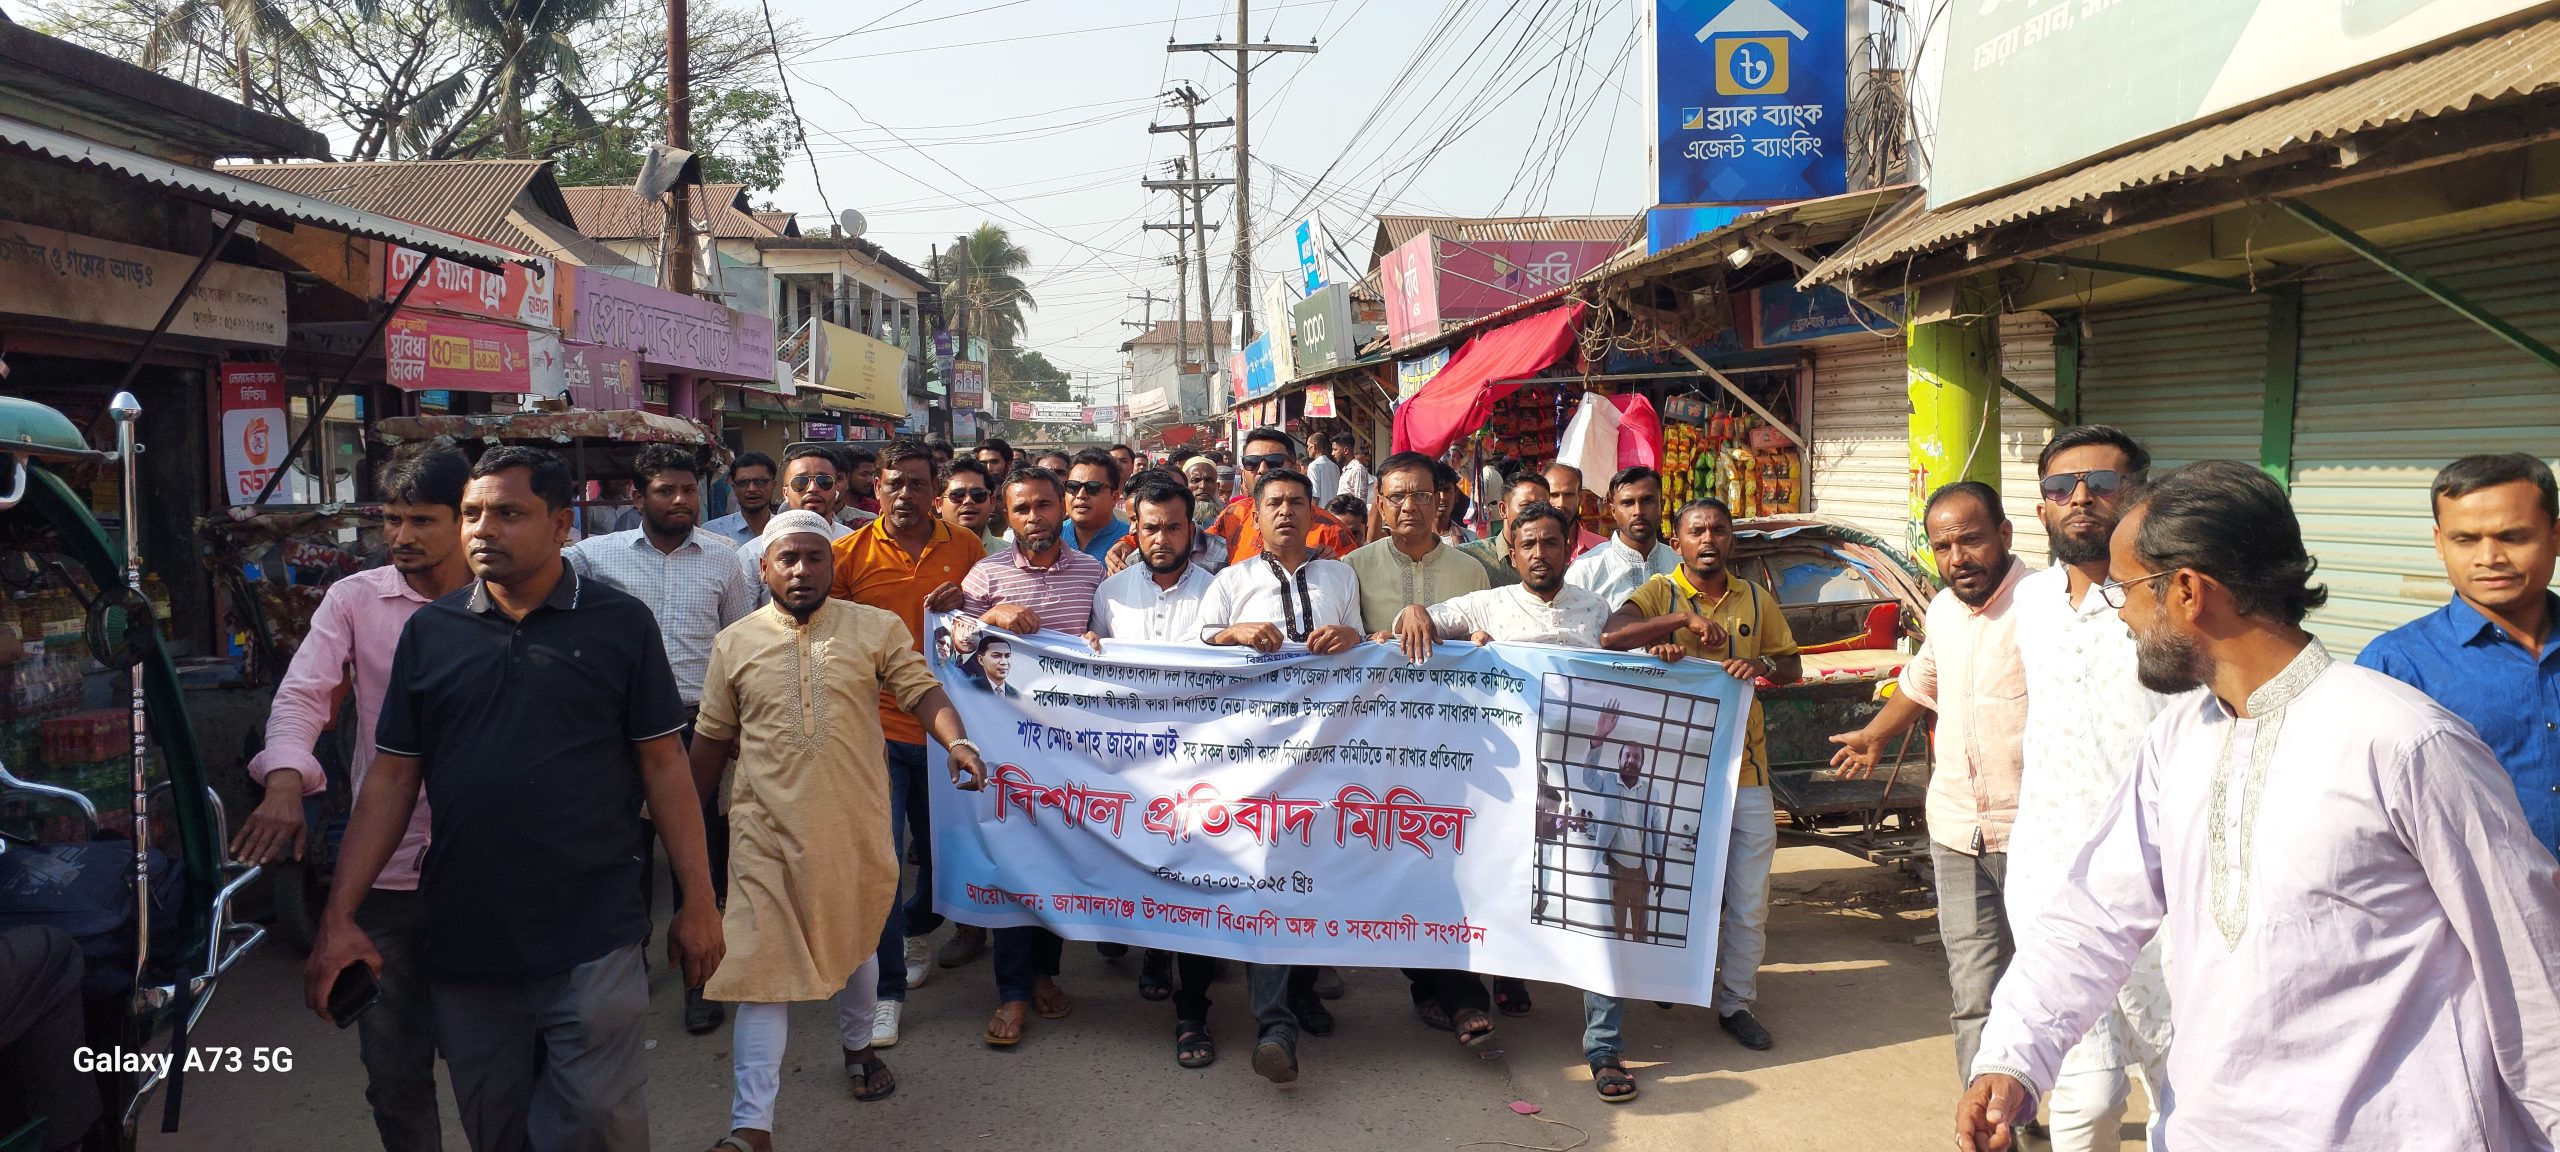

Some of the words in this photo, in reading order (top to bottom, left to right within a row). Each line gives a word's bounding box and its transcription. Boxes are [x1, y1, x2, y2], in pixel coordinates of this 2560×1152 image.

[1707, 106, 1757, 131] ব্র্যাক
[1762, 104, 1823, 128] ব্যাংক
[1683, 133, 1746, 160] এজেন্ট
[1751, 129, 1824, 159] ব্যাংকিং
[66, 248, 106, 278] গমের
[1403, 253, 1420, 303] রবি
[1526, 250, 1572, 289] রবি
[390, 328, 427, 360] সুবিধা
[588, 291, 684, 361] পোশাক
[685, 307, 732, 369] বাড়ি
[1303, 313, 1326, 353] oppo
[390, 358, 426, 382] ডাবল
[431, 339, 452, 366] ৫০
[1038, 655, 1088, 677] বাংলাদেশ
[1164, 670, 1181, 687] দল
[1184, 669, 1227, 691] বিএনপি
[1283, 664, 1330, 686] উপজেলা
[1332, 666, 1364, 685] শাখার
[1366, 667, 1388, 685] সদ্য
[1388, 662, 1425, 684] ঘোষিত
[1480, 666, 1526, 694] কমিটিতে
[1033, 684, 1071, 708] সর্বোচ্চ
[1073, 693, 1100, 710] ত্যাগ
[1102, 690, 1141, 712] স্বীকারী
[1145, 698, 1169, 712] কারা
[1172, 695, 1219, 714] নির্যাতিত
[1220, 697, 1246, 718] নেতা
[1249, 698, 1300, 719] জামালগঞ্জ
[1302, 695, 1350, 719] উপজেলা
[1350, 694, 1398, 719] বিএনপির
[1400, 700, 1434, 721] সাবেক
[1438, 702, 1479, 725] সাধারণ
[1481, 706, 1524, 729] সম্পাদক
[1017, 718, 1043, 751] শাহ
[1048, 726, 1073, 752] মোঃ
[1075, 730, 1104, 761] শাহ
[1106, 729, 1149, 761] জাহান
[1152, 725, 1181, 764] ভাই
[1183, 740, 1199, 762] সহ
[1200, 741, 1225, 764] সকল
[1226, 738, 1255, 764] ত্যাগী
[1258, 743, 1280, 765] কারা
[1281, 739, 1337, 766] নির্যাতিতদের
[1339, 738, 1383, 765] কমিটিতে
[1385, 746, 1398, 768] না
[1399, 746, 1428, 769] রাখার
[1429, 744, 1475, 773] প্রতিবাদে
[990, 762, 1136, 840] বিশাল
[1142, 779, 1326, 846] প্রতিবাদ
[1330, 783, 1476, 859] মিছিল
[1190, 873, 1287, 894] ০৭-০৩-২০২৫
[1052, 892, 1136, 920] জামালগঞ্জ
[1140, 895, 1213, 929] উপজেলা
[1216, 903, 1281, 938] বিএনপি
[1284, 917, 1319, 939] অঙ্গ
[1324, 919, 1340, 938] ও
[1345, 912, 1420, 942] সহযোগী
[1423, 916, 1489, 948] সংগঠন
